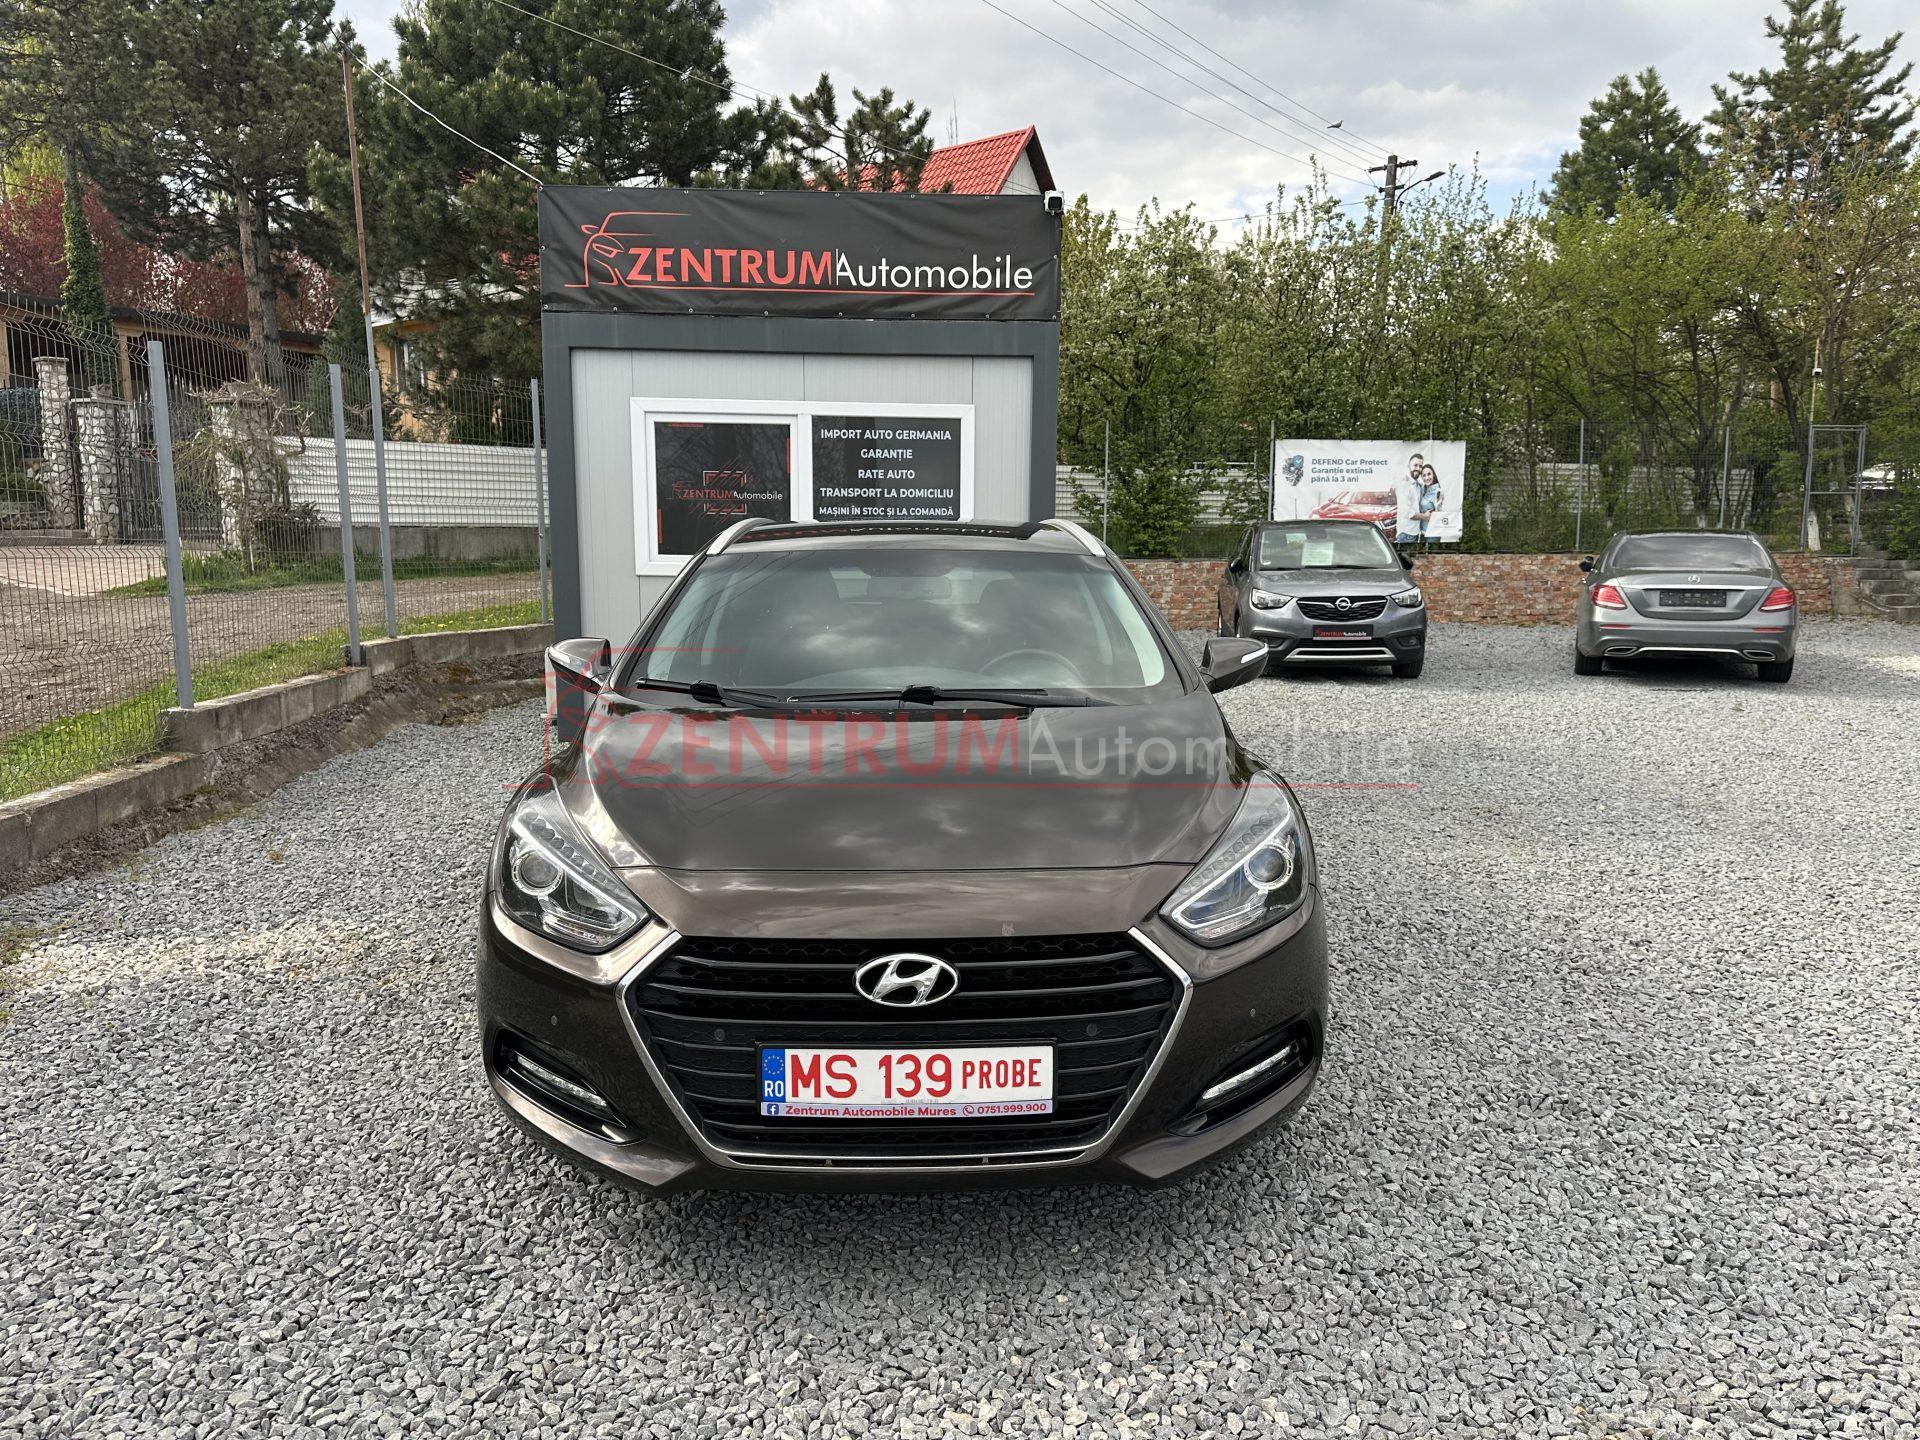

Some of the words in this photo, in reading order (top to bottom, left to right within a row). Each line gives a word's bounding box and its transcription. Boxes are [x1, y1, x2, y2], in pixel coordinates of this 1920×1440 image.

[628, 247, 832, 286] ZENTRUM
[837, 251, 1033, 289] Automobile
[820, 429, 862, 439] IMPORT
[864, 430, 893, 440] AUTO
[896, 430, 952, 440] GERMANIA
[860, 448, 913, 461] GARANȚIE
[1311, 458, 1344, 466] DEFEND
[1345, 458, 1359, 466] Car
[1360, 458, 1388, 466] Protect
[858, 469, 885, 479] RATE
[886, 469, 916, 480] AUTO
[1311, 467, 1344, 475] Garanție
[733, 490, 783, 500] Automobile
[820, 487, 882, 498] TRANSPORT
[884, 488, 897, 498] LA
[900, 488, 954, 499] DOMICILIU
[819, 506, 850, 517] MAȘINI
[851, 505, 861, 515] ÎN
[862, 507, 885, 516] STOC
[886, 507, 895, 518] ȘI
[896, 507, 908, 516] LA
[909, 506, 954, 516] COMANDĂ
[790, 1054, 858, 1099] MS
[878, 1054, 952, 1099] 139
[962, 1058, 1042, 1090] PROBE
[764, 1080, 784, 1098] RO
[785, 1105, 839, 1116] Zentrum
[842, 1105, 915, 1118] Automobile
[918, 1105, 957, 1117] Mures
[976, 1103, 1047, 1116] 0751.999.900
